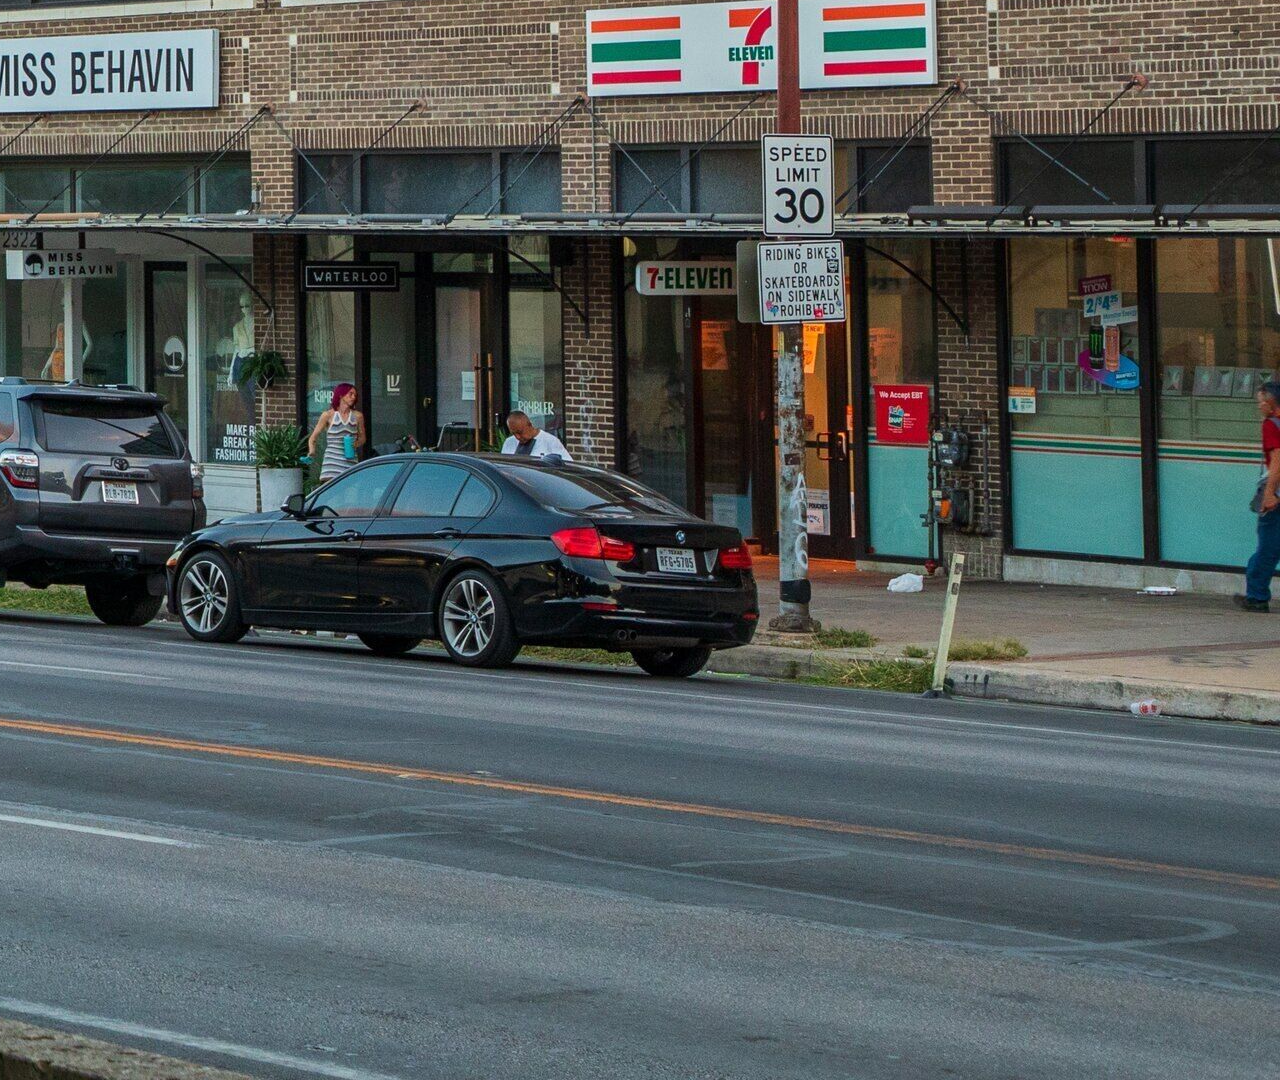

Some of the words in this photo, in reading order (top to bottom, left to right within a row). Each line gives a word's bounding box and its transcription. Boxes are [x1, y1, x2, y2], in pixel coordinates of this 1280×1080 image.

[71, 47, 194, 95] BEHAVIN
[769, 147, 827, 162] SPEED
[776, 167, 820, 182] LIMIT
[774, 187, 824, 224] 30
[2, 231, 39, 249] 2322
[48, 253, 83, 262] MISS
[765, 248, 801, 261] RIDING
[806, 247, 837, 260] BIKES
[48, 265, 113, 276] BEHAVIN
[793, 262, 808, 274] OR
[314, 271, 388, 283] WATERLOO
[765, 275, 840, 290] SKATEBOARDS
[768, 291, 782, 303] ON
[788, 289, 840, 303] SIDEWALK
[879, 391, 889, 399] We
[890, 391, 911, 400] Accept
[911, 391, 924, 399] EBT
[226, 423, 248, 436] MAKE
[223, 435, 248, 448] BREAK
[215, 448, 247, 462] FASHION
